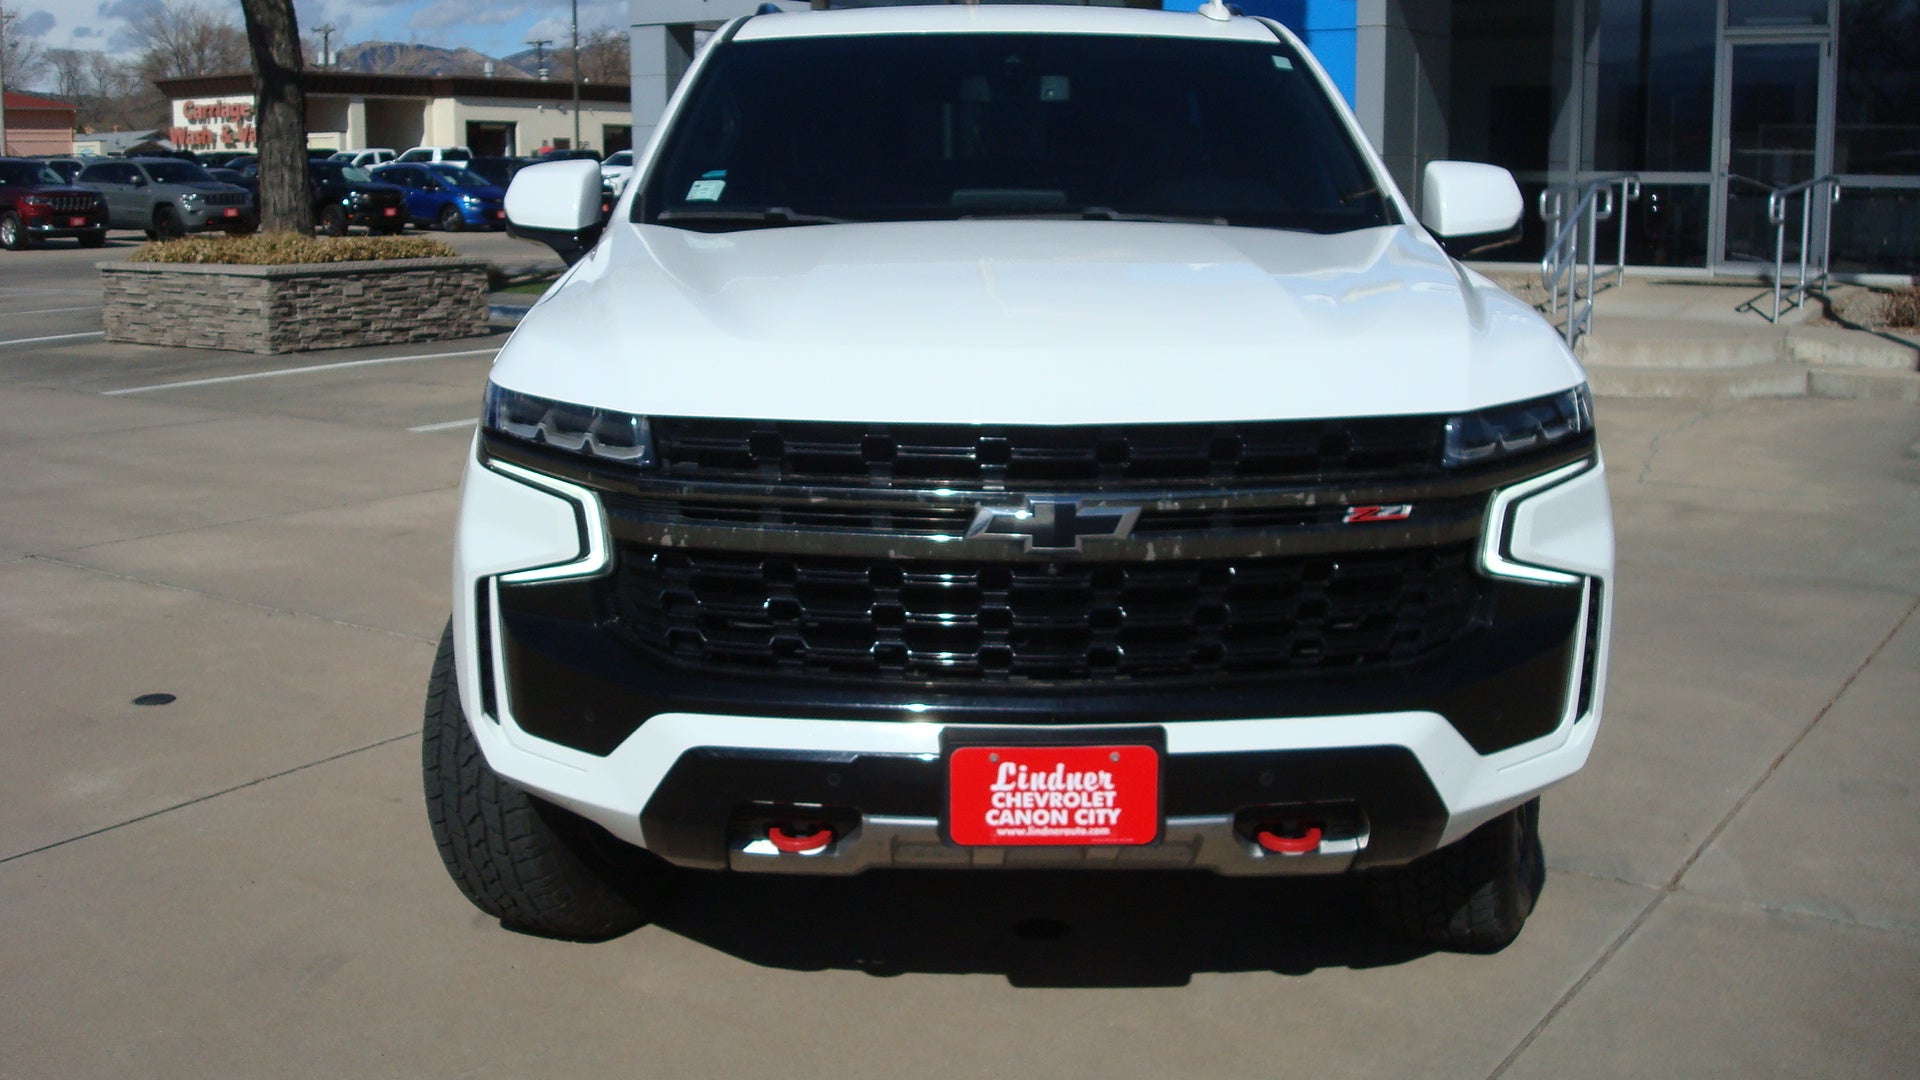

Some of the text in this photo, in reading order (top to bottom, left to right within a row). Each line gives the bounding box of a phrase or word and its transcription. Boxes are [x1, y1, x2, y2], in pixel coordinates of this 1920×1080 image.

[183, 101, 250, 122] Carriage
[168, 126, 211, 145] Wash
[221, 125, 235, 144] &
[990, 761, 1115, 791] Lindner
[991, 791, 1117, 808] CHEVROLET
[985, 808, 1121, 826] CANON CITY
